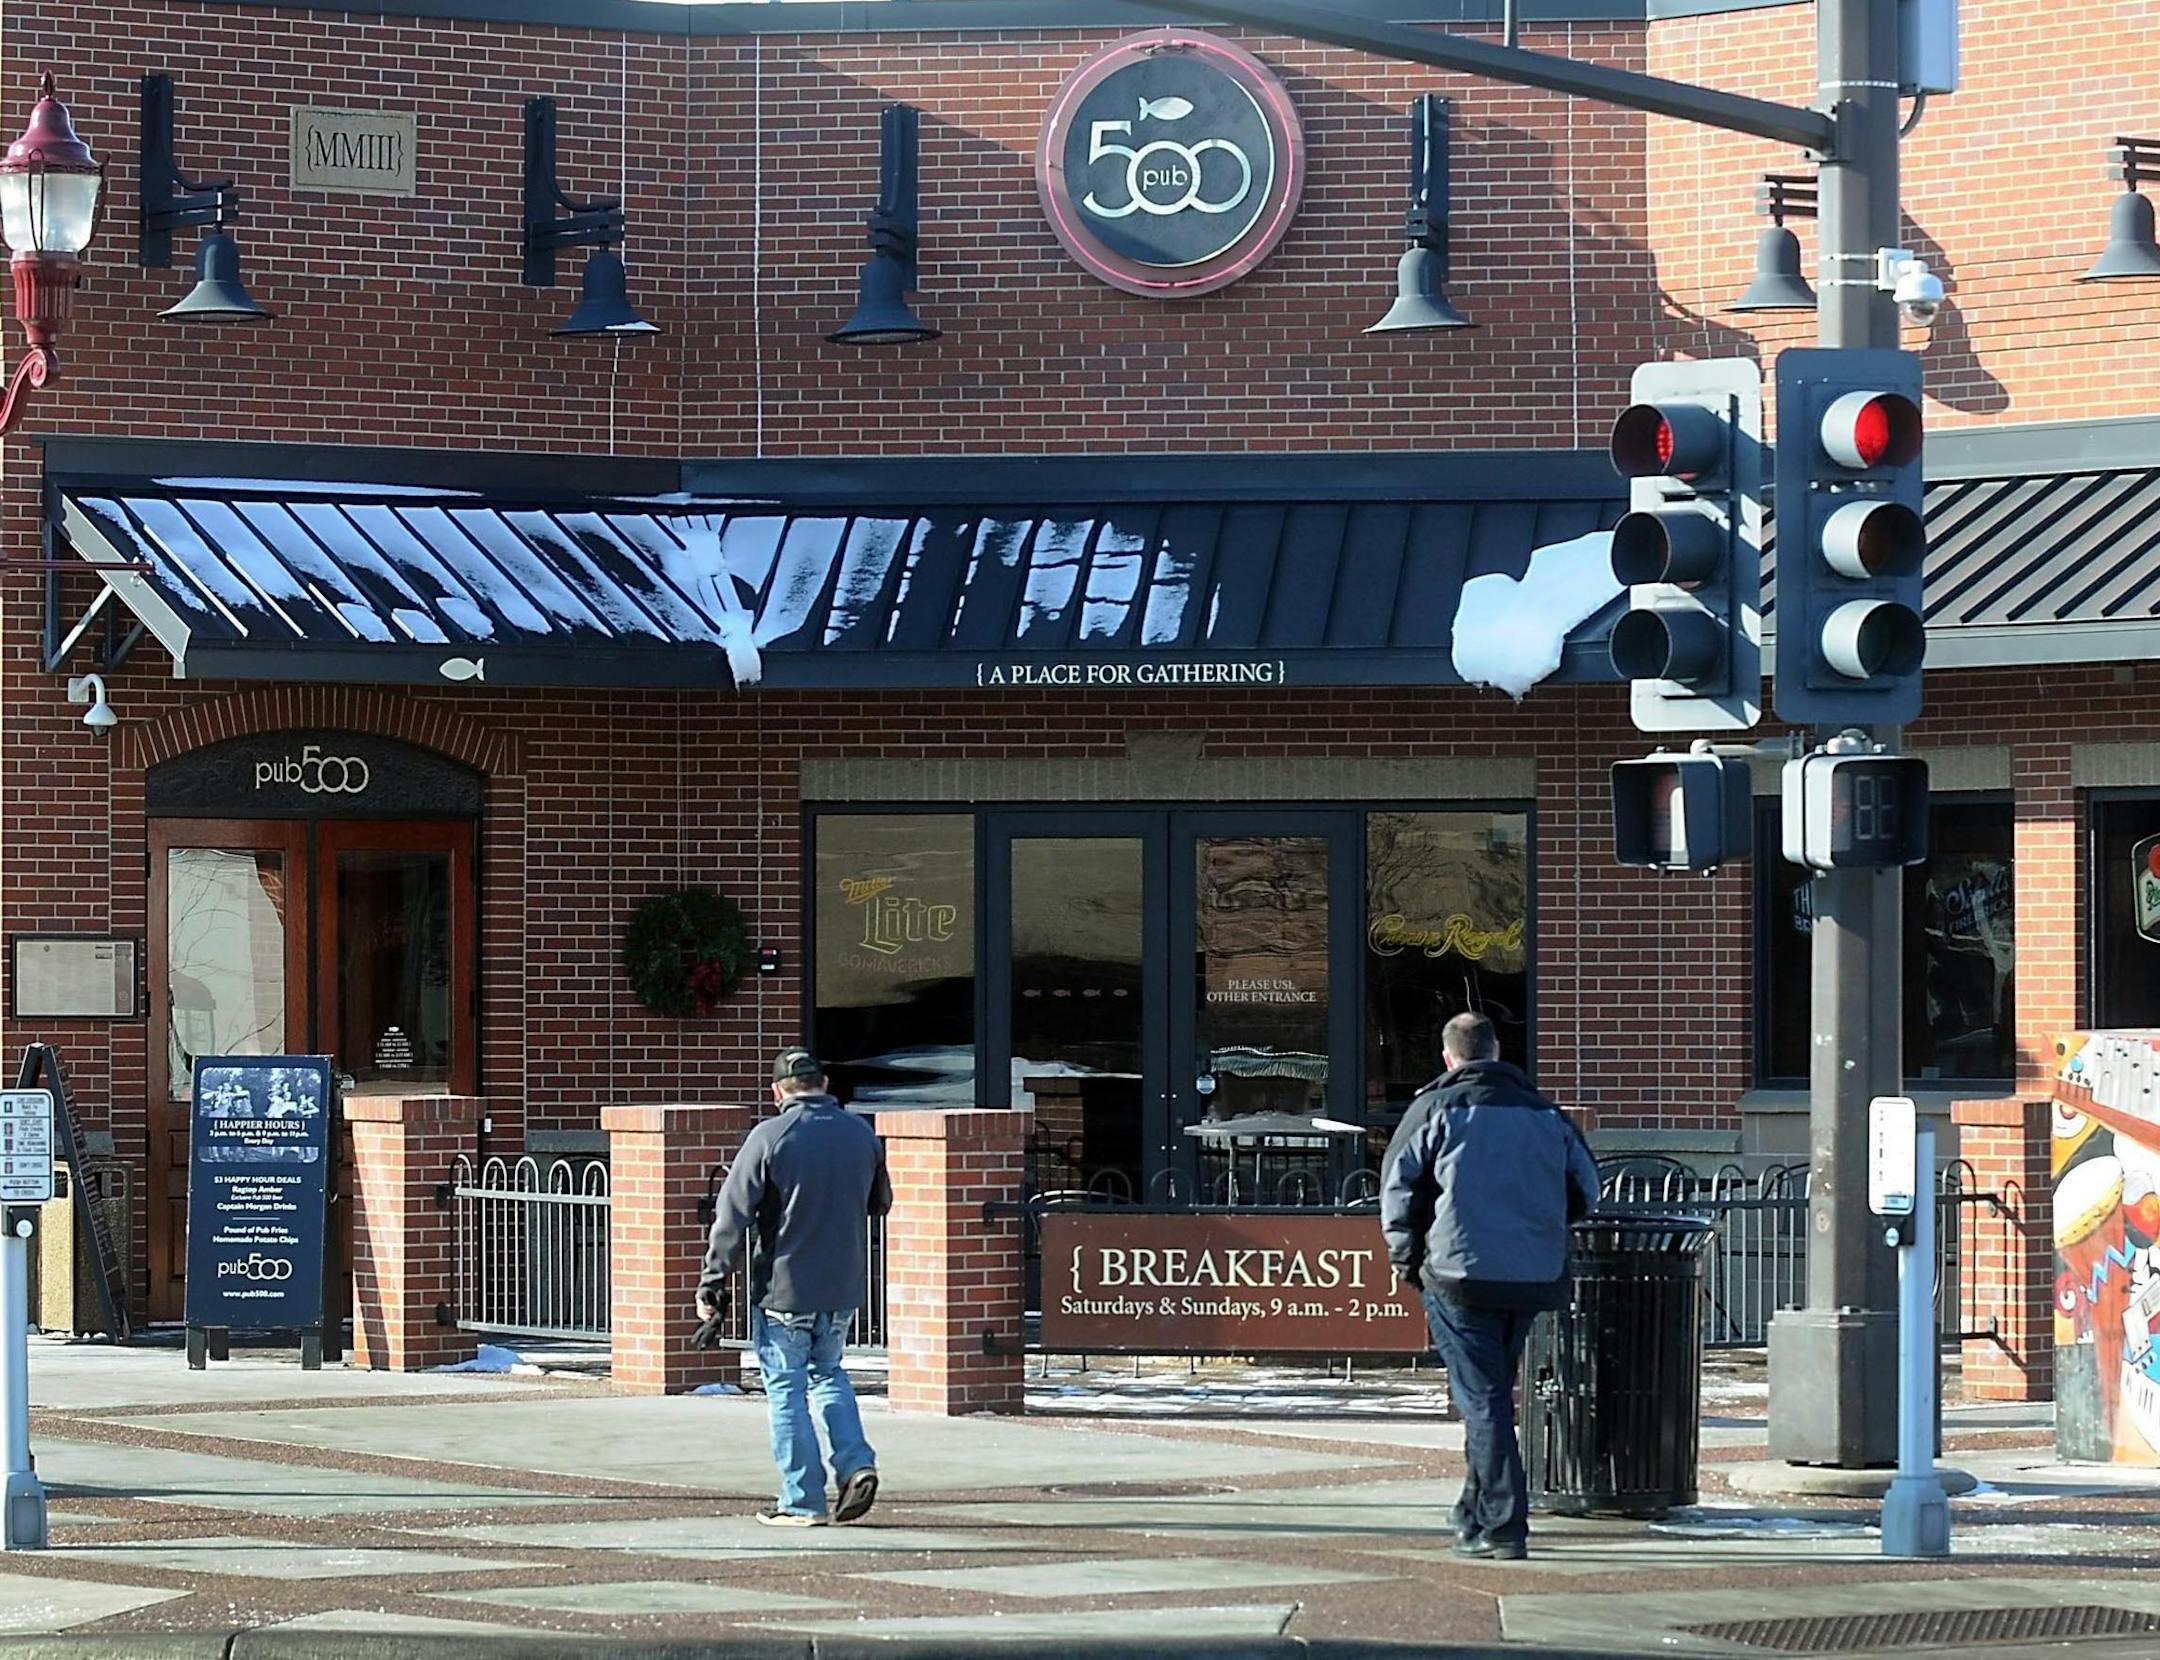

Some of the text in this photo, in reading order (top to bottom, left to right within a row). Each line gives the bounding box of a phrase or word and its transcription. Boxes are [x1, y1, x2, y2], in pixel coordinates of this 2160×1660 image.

[1083, 120, 1252, 218] 500
[1142, 164, 1188, 192] pub
[988, 665, 1004, 684] A
[1011, 665, 1080, 684] PLACE
[1086, 664, 1132, 684] FOR
[1136, 662, 1273, 684] GATHERING
[858, 897, 957, 955] Lite
[1228, 979, 1271, 990] PLEASE
[1206, 991, 1317, 1002] OTHER ENTRANCE
[219, 1120, 263, 1129] HAPPIER
[265, 1120, 300, 1129] HOURS
[224, 1176, 251, 1184] HAPPY
[251, 1176, 275, 1184] HOUR
[276, 1176, 303, 1184] DEALS
[258, 1186, 284, 1194] Amber
[216, 1203, 298, 1212] Captain Morgan Drinks
[223, 1226, 247, 1234] Pound
[256, 1226, 270, 1234] Pub
[271, 1226, 289, 1234] Fries
[212, 1236, 299, 1245] Homemade Potato Chips
[1098, 1248, 1373, 1288] BREAKFAST
[1060, 1296, 1154, 1320] Saturdays
[1159, 1301, 1176, 1316] &
[1181, 1297, 1267, 1321] Sundays,
[1270, 1299, 1281, 1317] 9
[1287, 1303, 1329, 1317] a.m.
[1348, 1299, 1361, 1317] 2
[1365, 1302, 1410, 1322] p.m.
